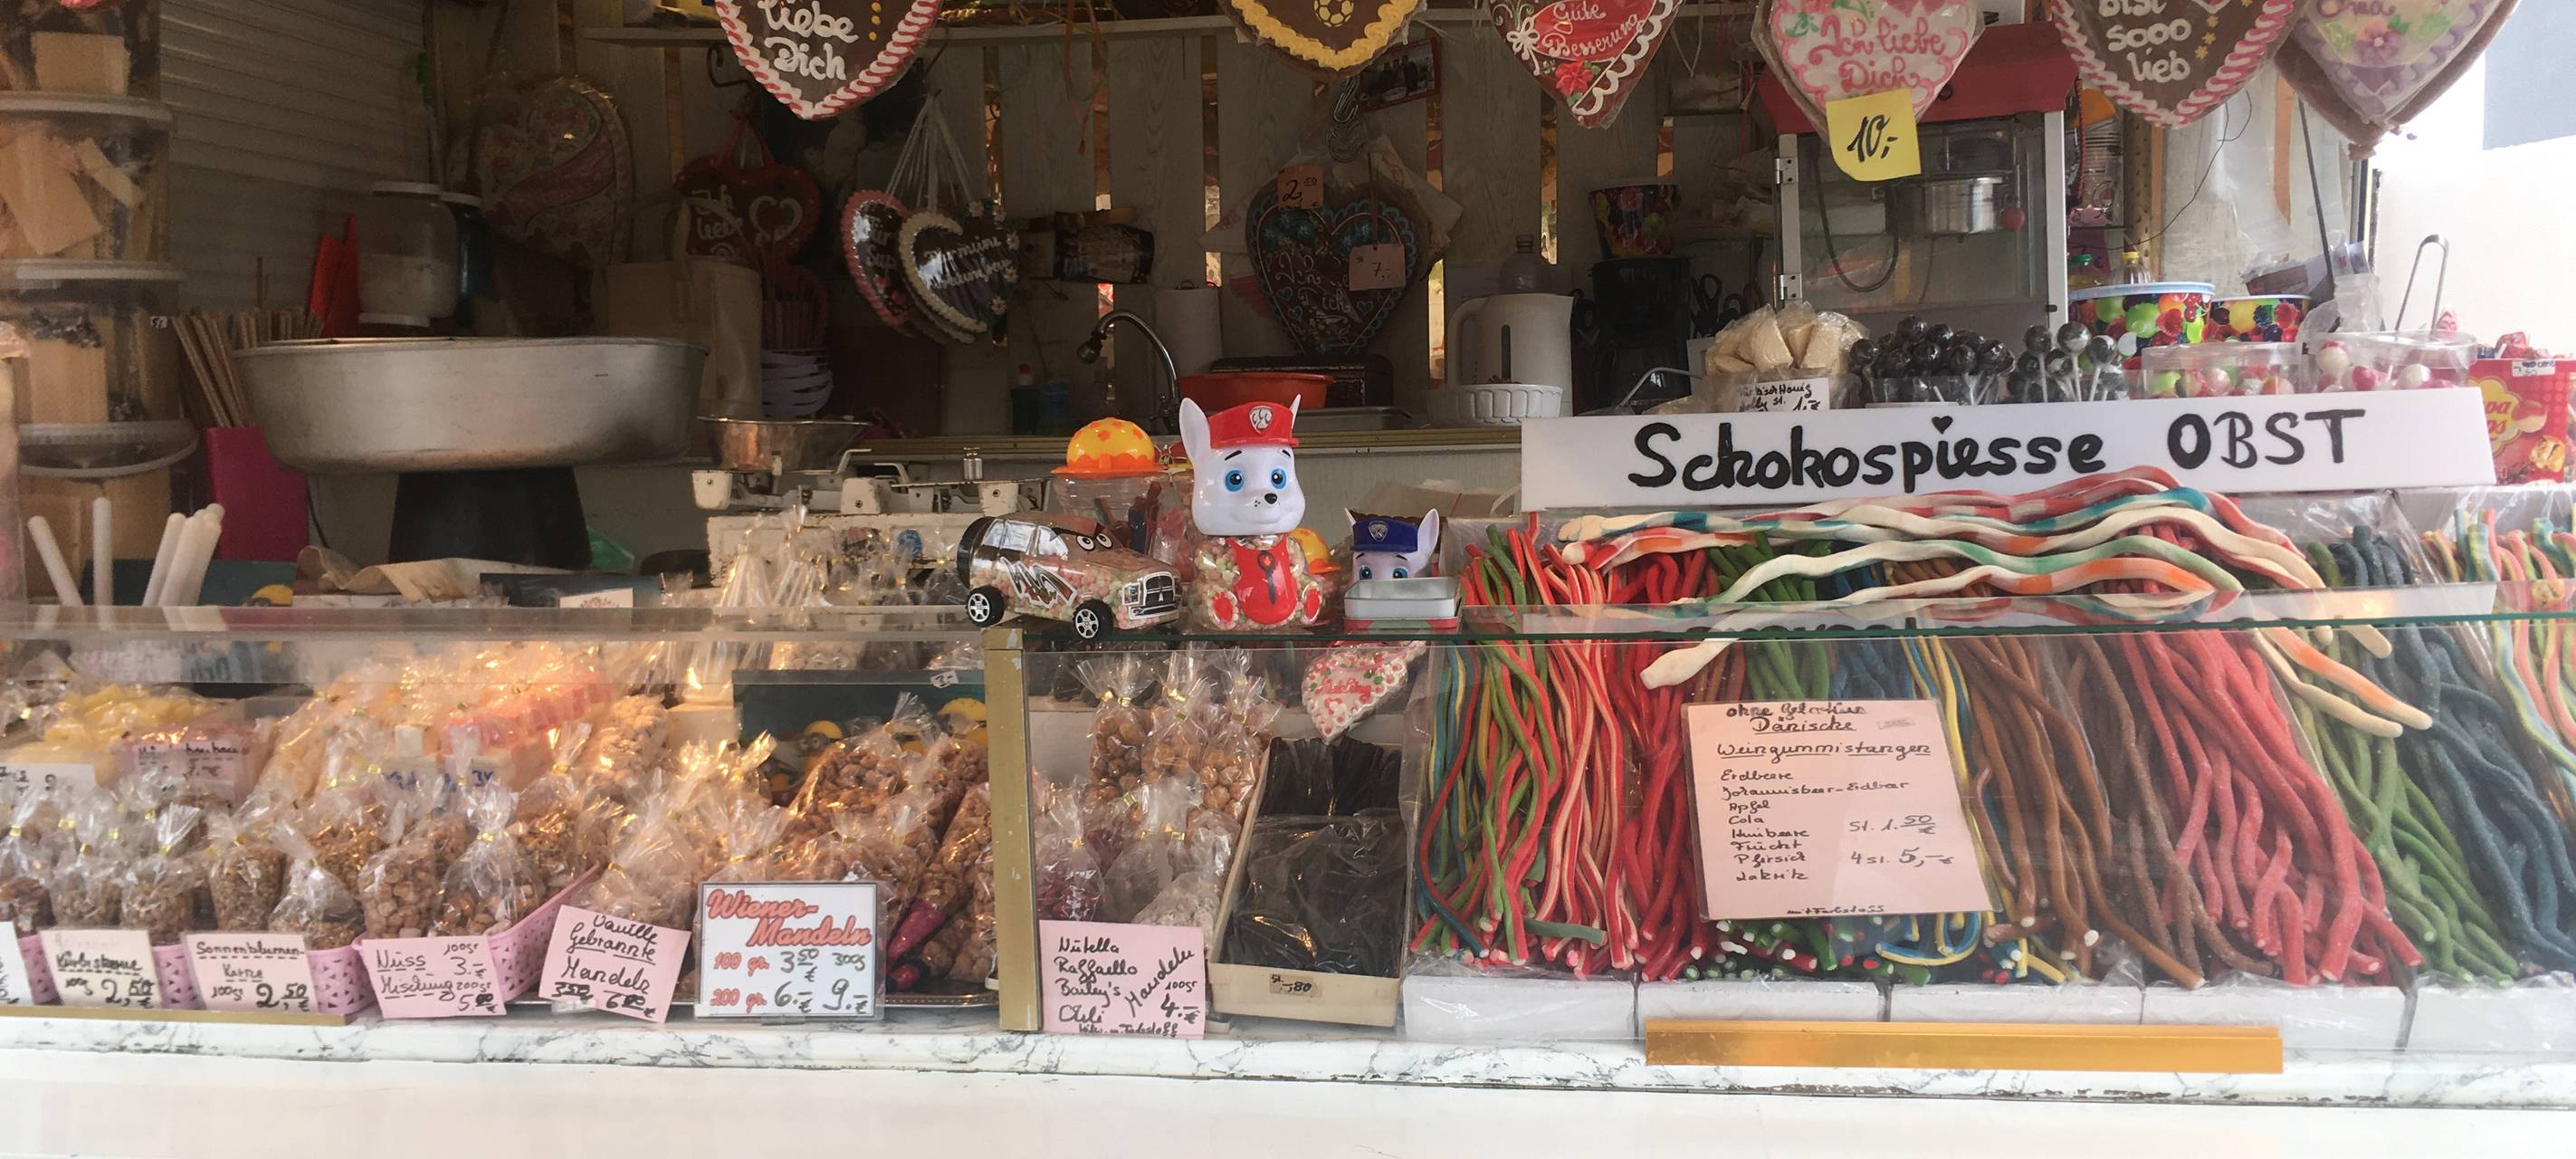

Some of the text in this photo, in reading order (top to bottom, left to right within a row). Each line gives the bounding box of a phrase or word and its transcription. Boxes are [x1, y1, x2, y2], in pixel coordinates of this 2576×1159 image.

[1542, 14, 1645, 57] Besserung
[1808, 16, 1945, 65] Ich liebe
[764, 36, 846, 81] Dich
[2126, 47, 2190, 82] lieb
[1839, 55, 1922, 89] Dich
[1627, 408, 2366, 493] Schokospiesse OBST
[1726, 704, 1773, 717] ohne
[1750, 714, 1857, 733] Dänische
[1717, 742, 1932, 764] Weingummistangen
[1721, 769, 1793, 781] Erdbeere
[1728, 814, 1765, 825] Cola
[1729, 800, 1770, 814] Apfel
[1734, 851, 1807, 868] Pfirsich
[706, 888, 819, 920] Wiener-
[566, 922, 656, 962] Gebrannte
[745, 915, 873, 948] Mandeln
[196, 940, 305, 955] Sonnenblumen-
[223, 963, 263, 979] Kerne
[560, 955, 650, 994] Mandeln
[713, 952, 742, 971] 100
[1054, 955, 1139, 985] Raffaello
[710, 988, 740, 1007] 200
